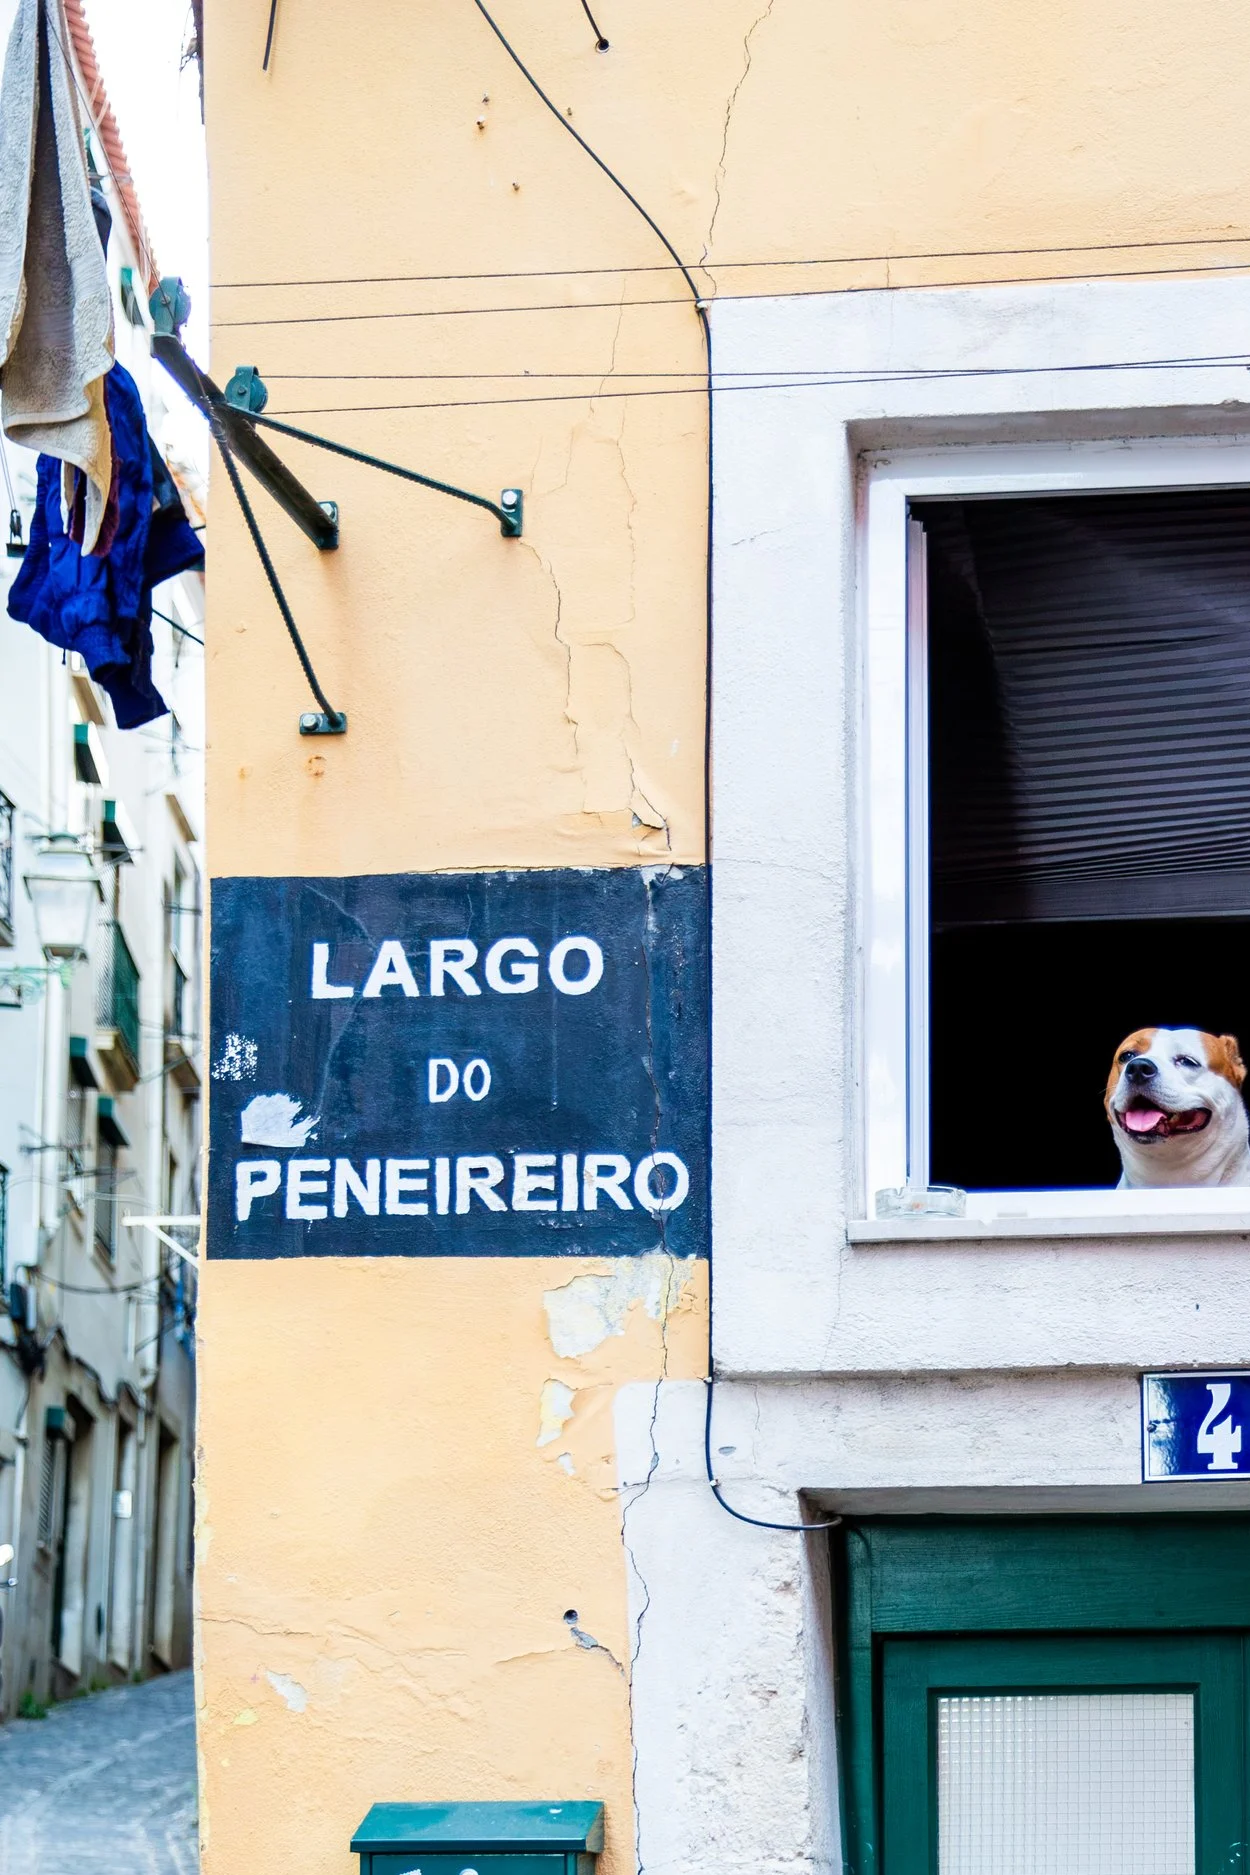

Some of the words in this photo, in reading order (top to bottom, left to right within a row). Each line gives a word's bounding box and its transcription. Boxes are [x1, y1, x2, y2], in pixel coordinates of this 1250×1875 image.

[311, 935, 604, 1000] LARGO
[427, 1057, 492, 1103] DO
[236, 1151, 690, 1222] PENEIREIRO
[1196, 1383, 1242, 1470] 4
